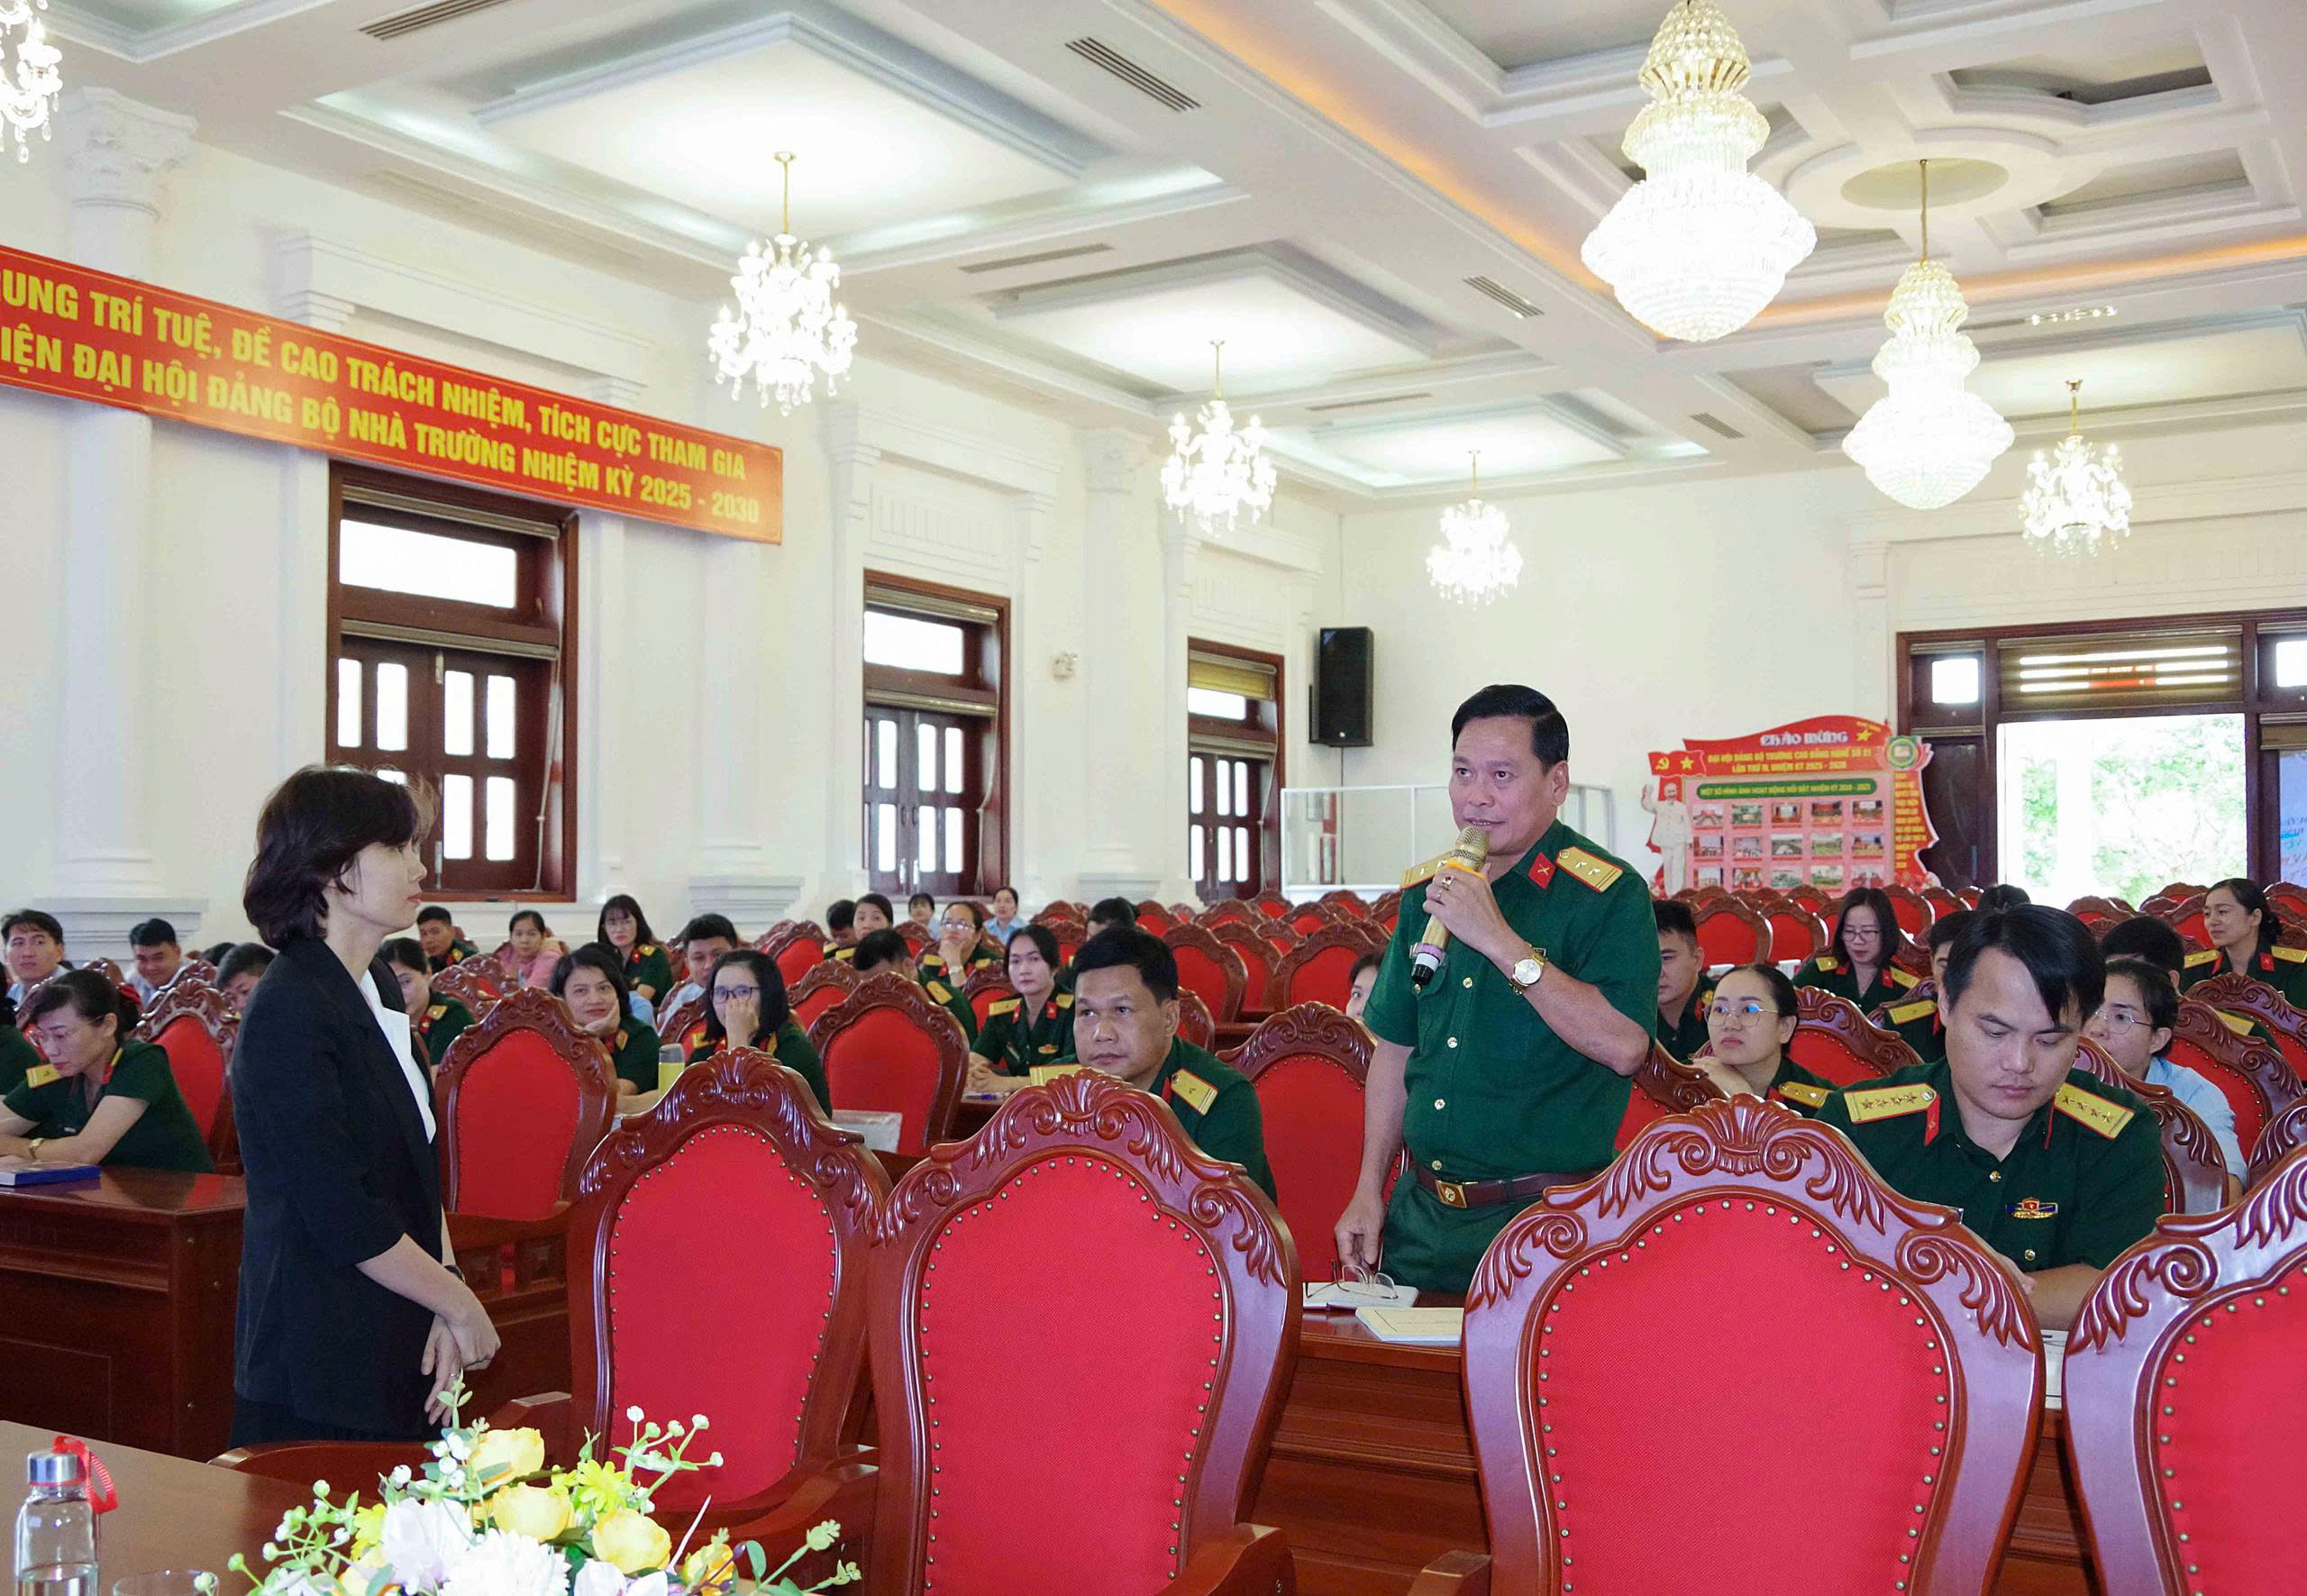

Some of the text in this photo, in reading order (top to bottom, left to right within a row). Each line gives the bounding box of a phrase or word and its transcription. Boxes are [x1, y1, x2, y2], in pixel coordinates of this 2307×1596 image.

[0, 269, 746, 480] UNG TRÍ TUỆ, ĐỀ CAO TRÁCH NHIỆM, TÍCH CỰC THAM GIA
[0, 323, 61, 374] IỆN
[72, 342, 132, 393] ĐẠI
[142, 359, 197, 406] HỘI
[206, 370, 293, 424] ĐẢNG
[302, 396, 341, 441] BỘ
[348, 407, 407, 450] NHÀ
[414, 422, 515, 474] TRƯỜNG
[522, 447, 599, 492] NHIỆM
[606, 463, 634, 498] KỲ
[640, 474, 692, 510] 2025
[710, 490, 760, 526] 2030
